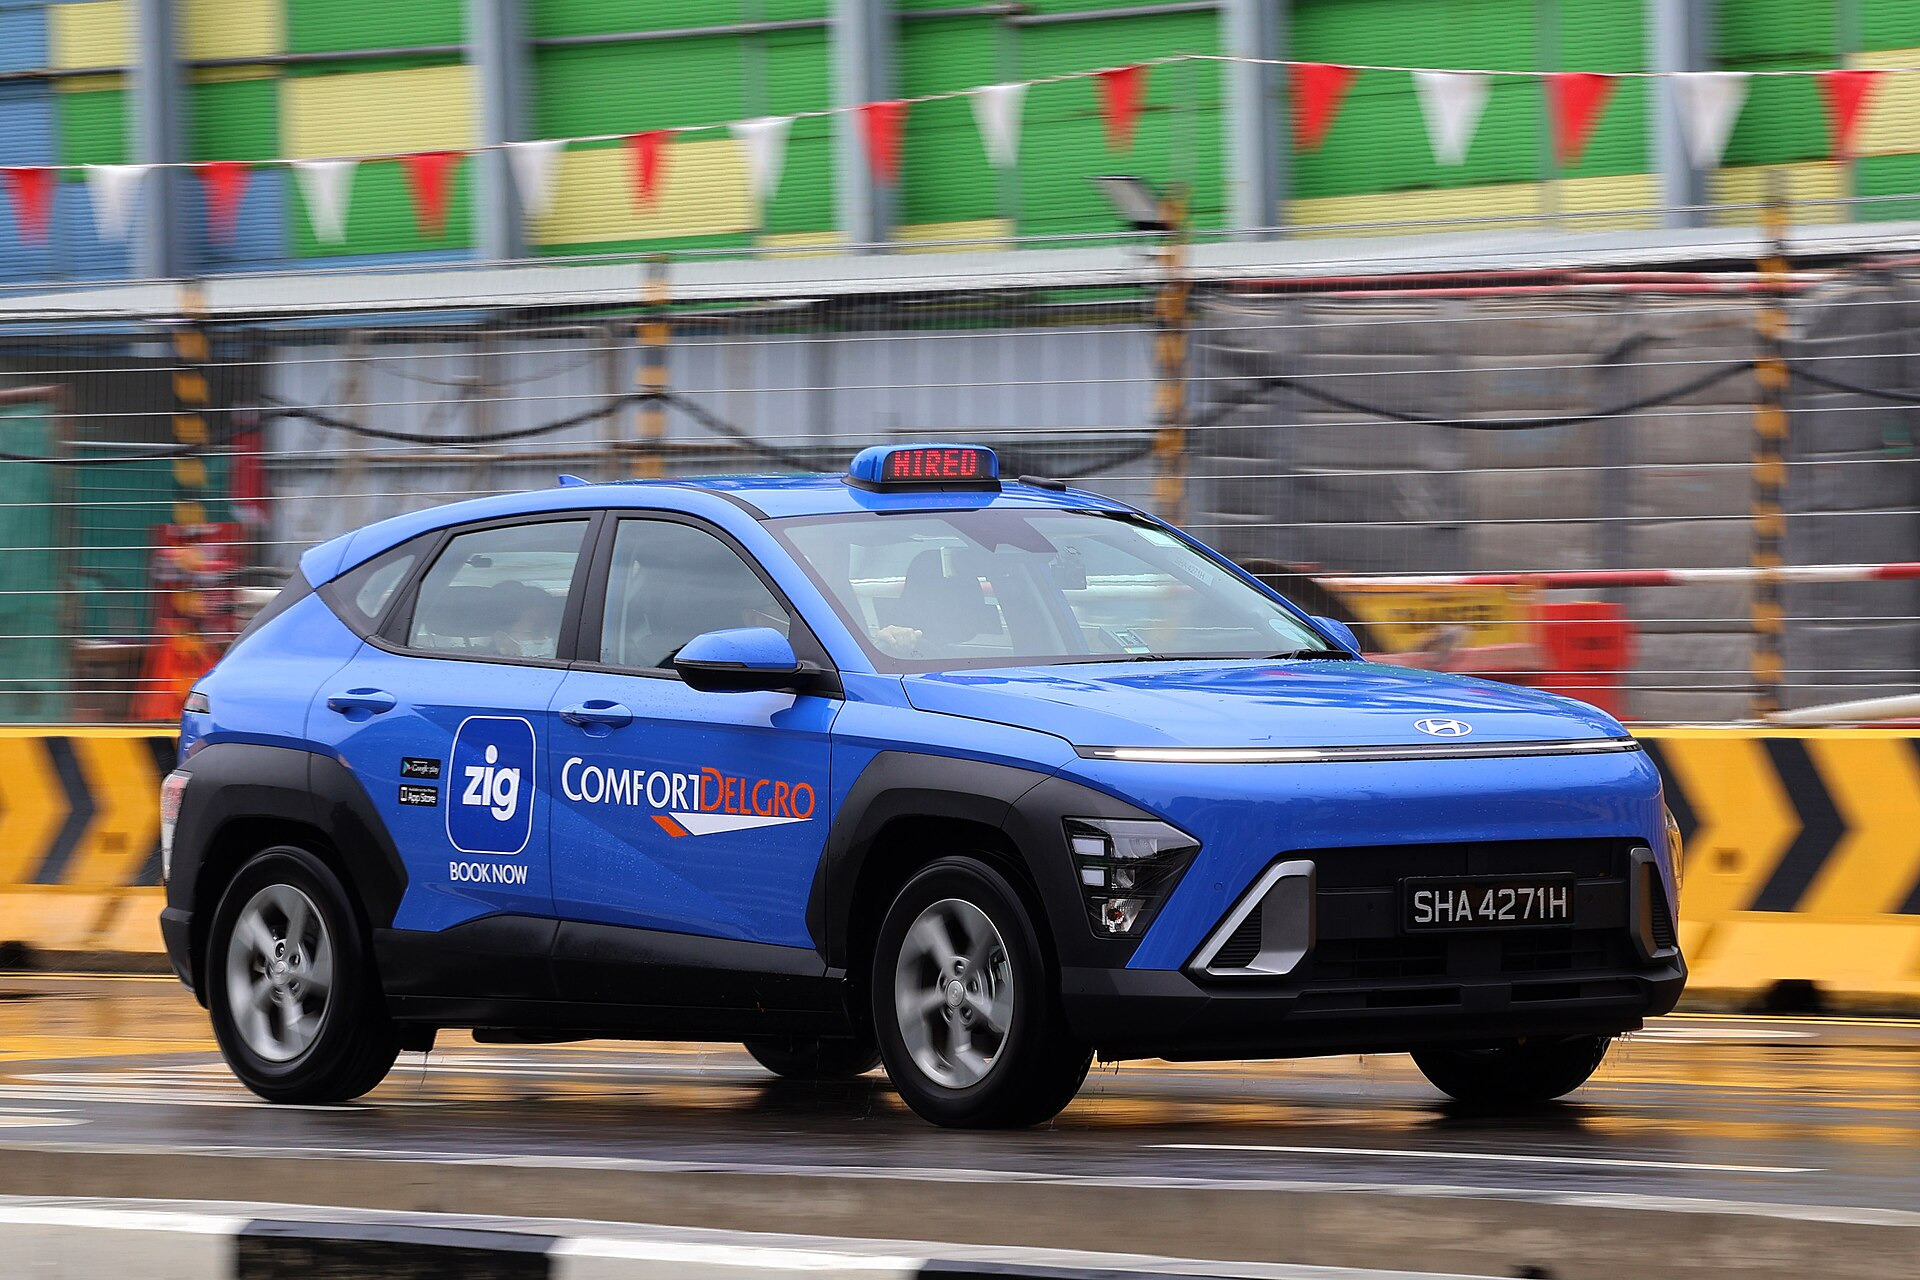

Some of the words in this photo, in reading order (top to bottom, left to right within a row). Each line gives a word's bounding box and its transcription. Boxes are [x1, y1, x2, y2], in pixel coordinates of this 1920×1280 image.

[893, 449, 977, 477] HIRED
[462, 744, 520, 821] zig
[449, 861, 490, 883] BOOK
[491, 863, 528, 885] NOW
[1414, 889, 1473, 923] SHA
[1478, 886, 1567, 921] 4271H
